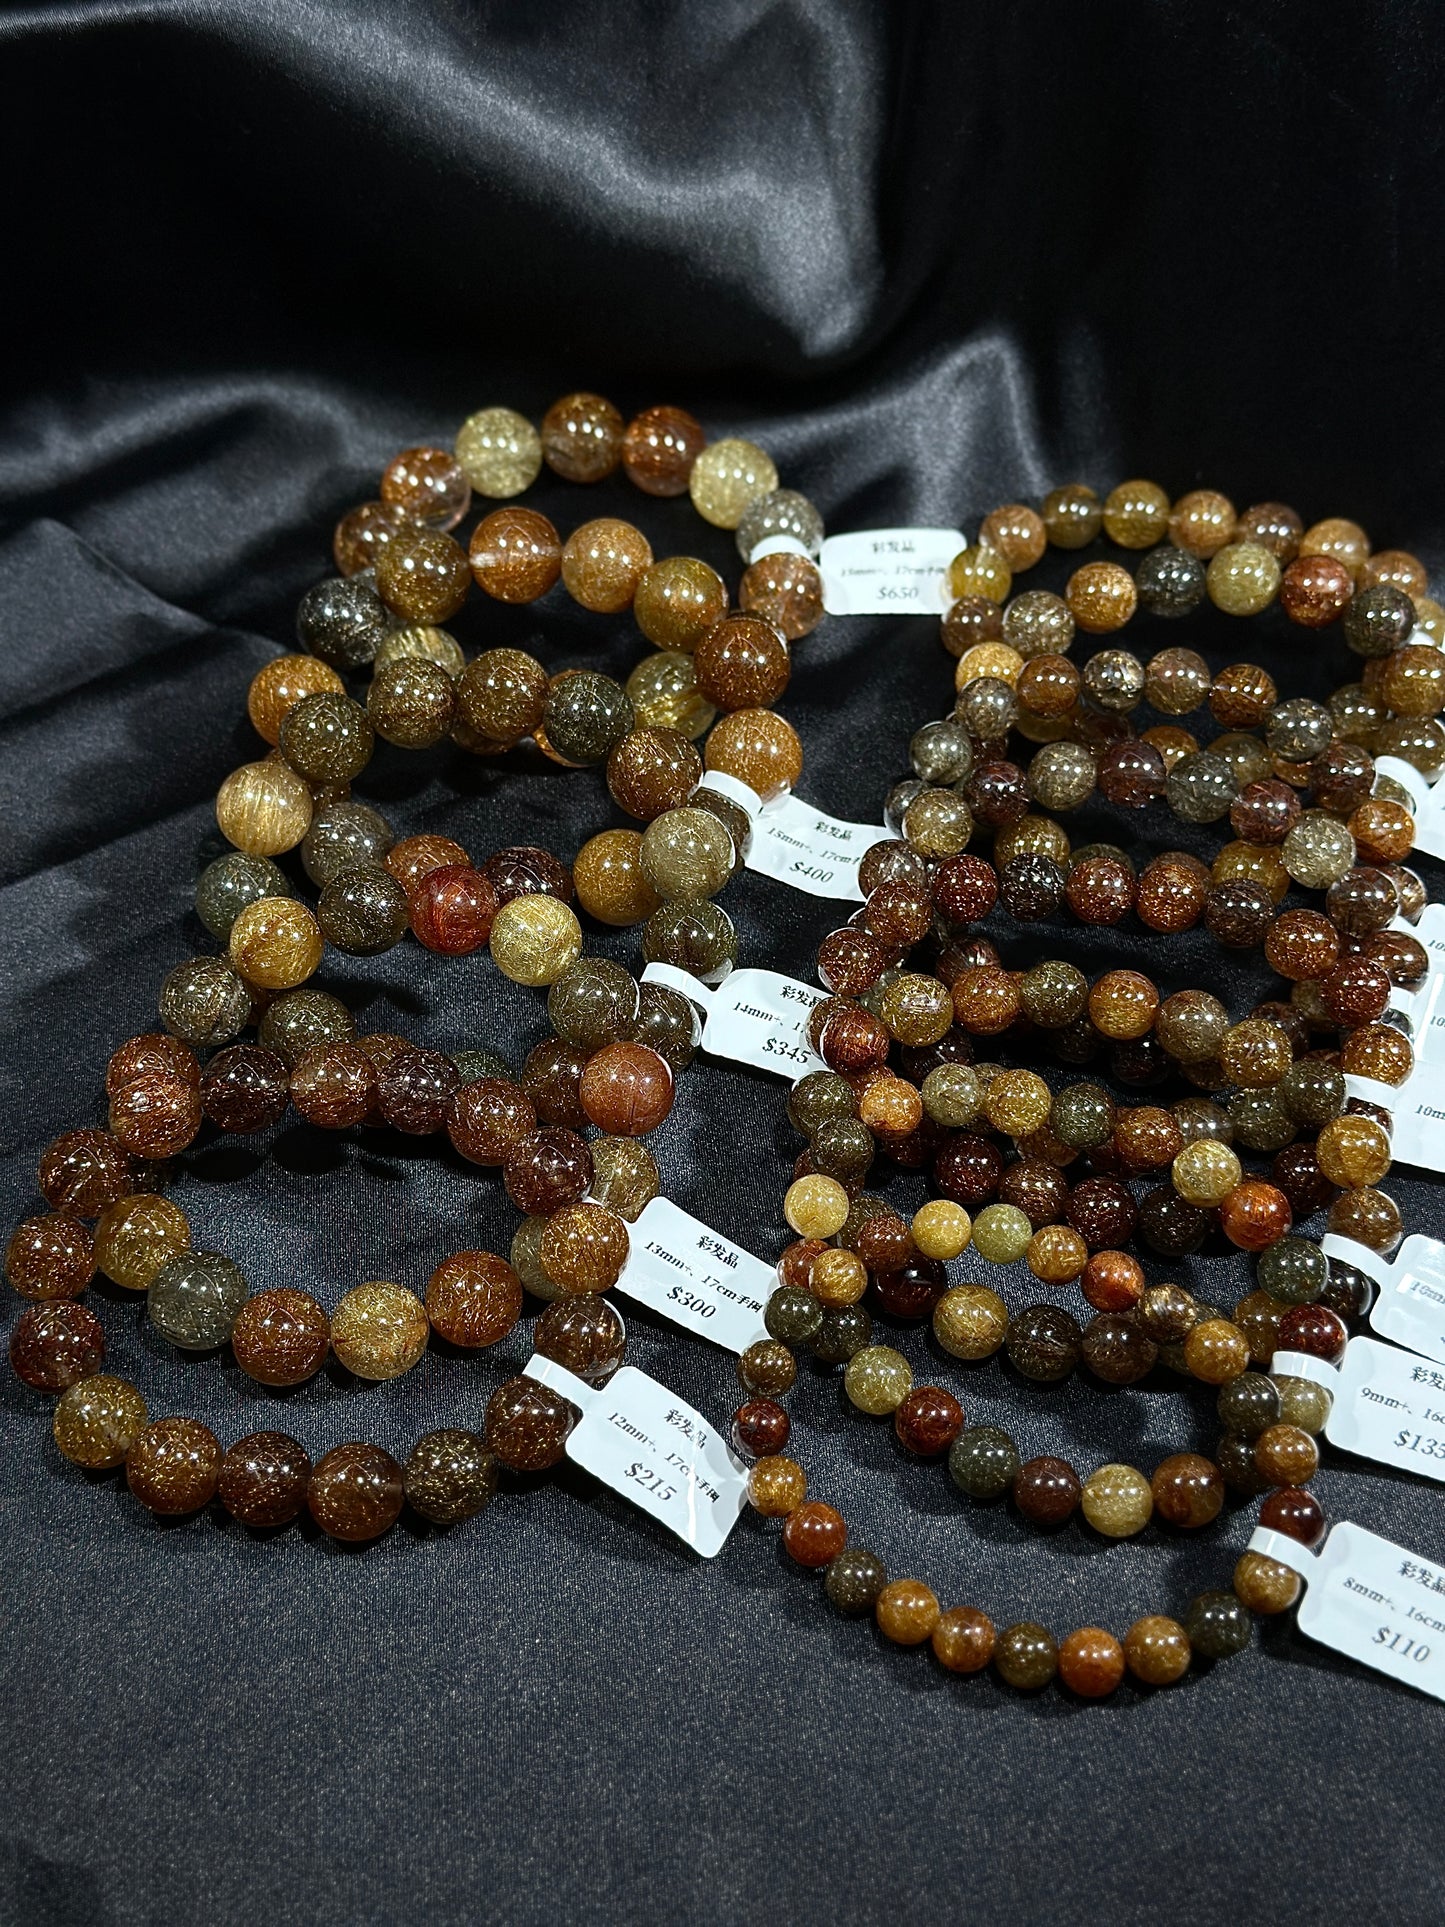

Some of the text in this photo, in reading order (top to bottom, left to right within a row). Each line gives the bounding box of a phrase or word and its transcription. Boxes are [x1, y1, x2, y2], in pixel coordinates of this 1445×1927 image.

[877, 586, 919, 600] $650
[814, 821, 852, 841] 彩发晶
[789, 862, 834, 883] $400
[762, 1037, 811, 1063] $345
[696, 1235, 739, 1269] 彩发晶
[666, 1286, 716, 1318] $300
[1409, 1366, 1445, 1391] 彩发
[1393, 1428, 1445, 1459] $135
[624, 1462, 677, 1501] $215
[1371, 1625, 1431, 1663] $110
